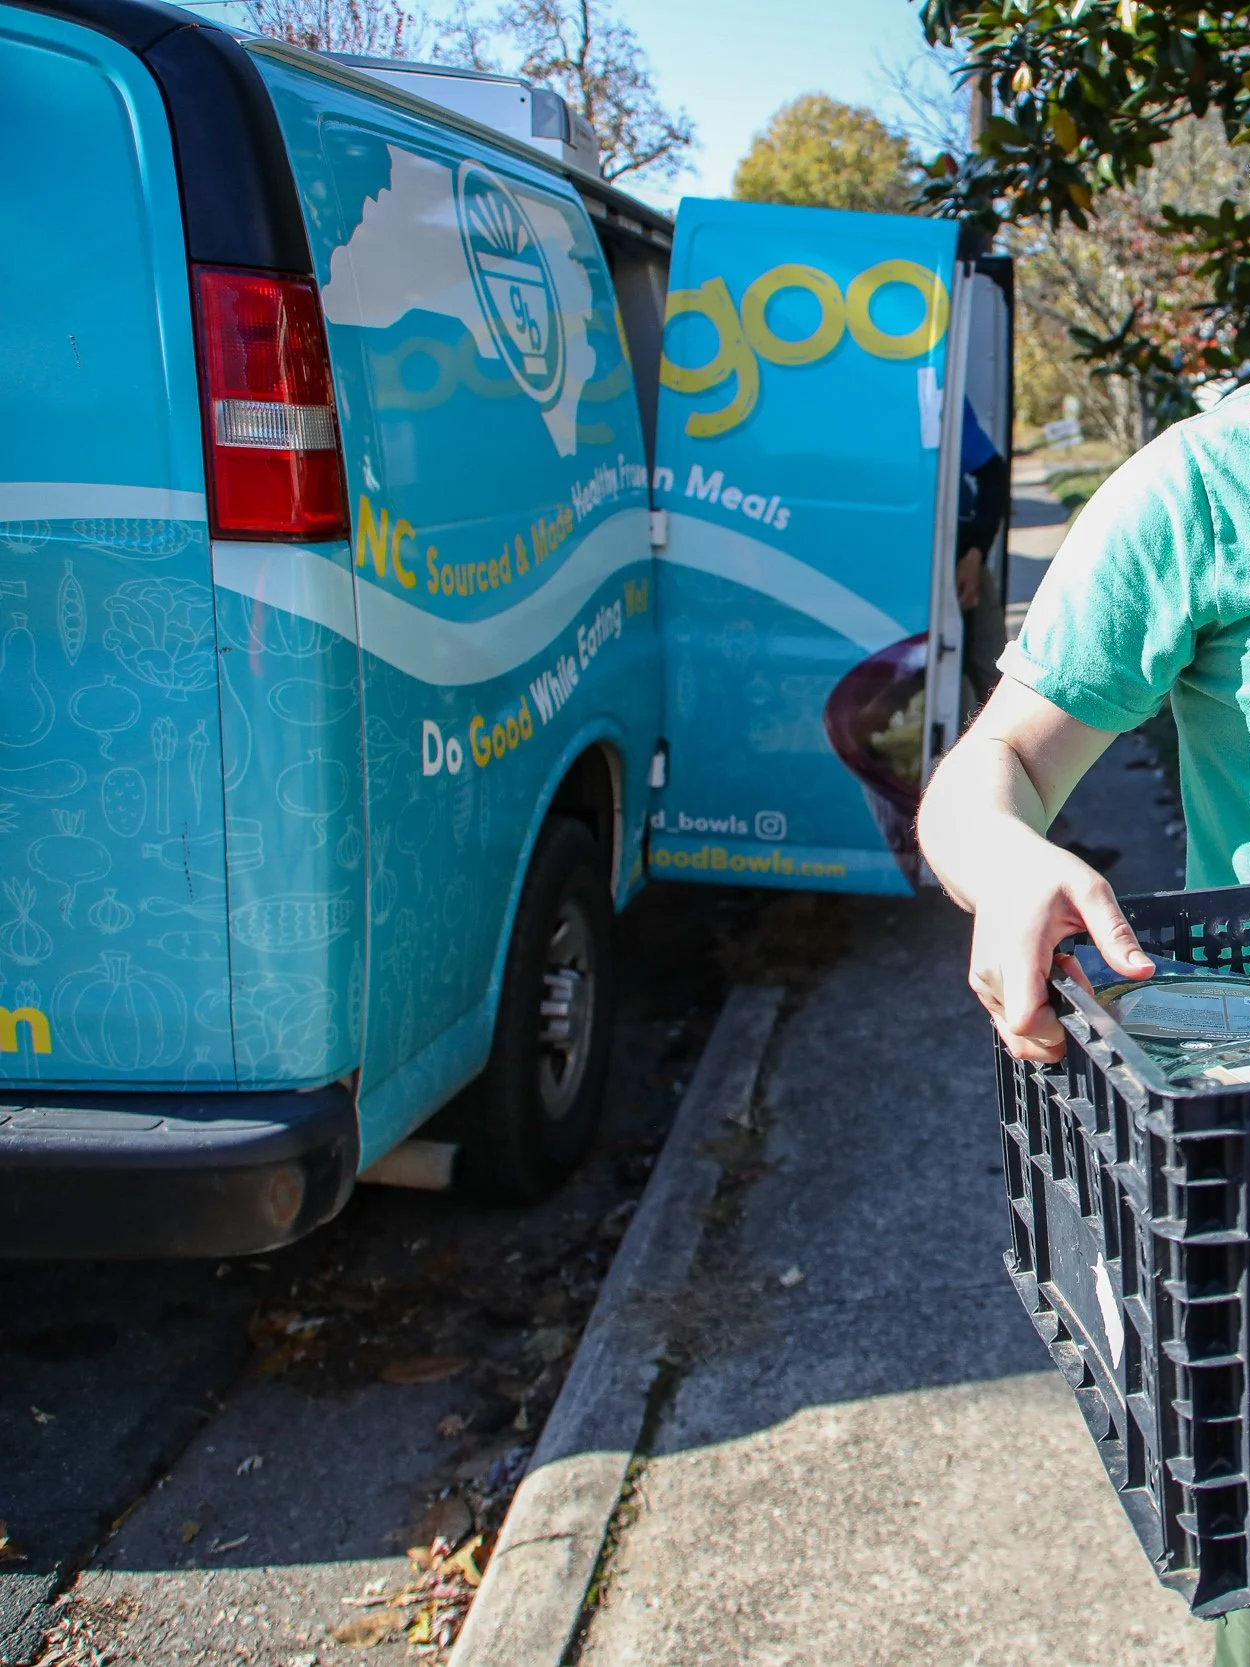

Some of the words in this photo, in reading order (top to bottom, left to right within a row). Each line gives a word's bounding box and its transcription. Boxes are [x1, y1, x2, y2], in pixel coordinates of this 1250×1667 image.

[509, 285, 541, 352] gb
[659, 259, 950, 437] goo
[355, 494, 416, 589] NC
[426, 545, 511, 596] Sourced
[514, 533, 529, 575] &
[531, 504, 574, 567] Made
[684, 464, 791, 531] Meals
[422, 719, 463, 776] Do
[469, 694, 533, 767] Good
[529, 654, 579, 726] While
[577, 599, 622, 671] Eating
